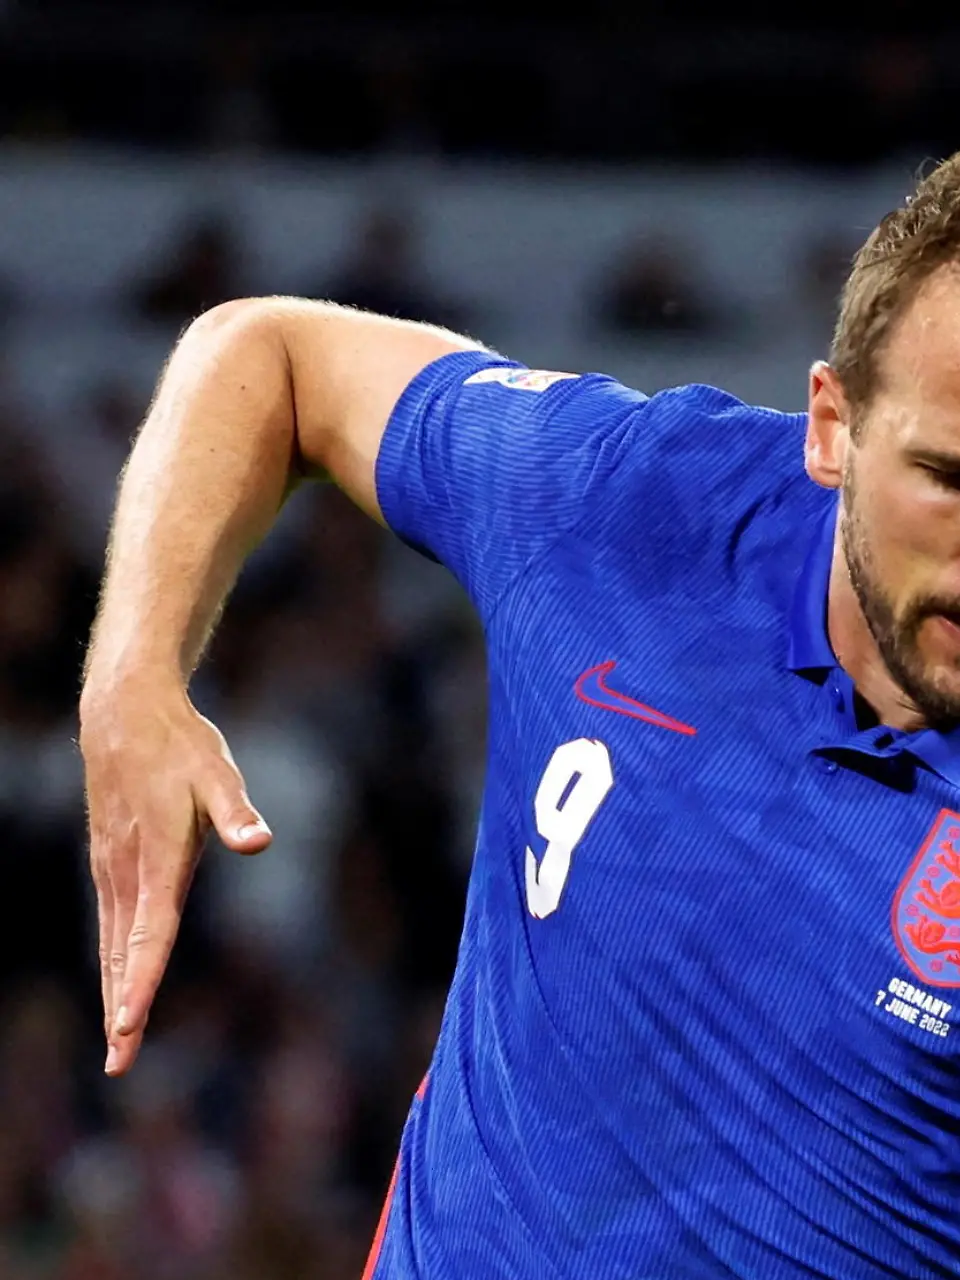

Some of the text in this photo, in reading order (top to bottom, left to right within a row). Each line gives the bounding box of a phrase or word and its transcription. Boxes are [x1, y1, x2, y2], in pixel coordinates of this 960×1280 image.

[524, 736, 615, 921] 9
[875, 989, 950, 1037] 7 JUNE 2022
[888, 977, 952, 1019] GERMANY
